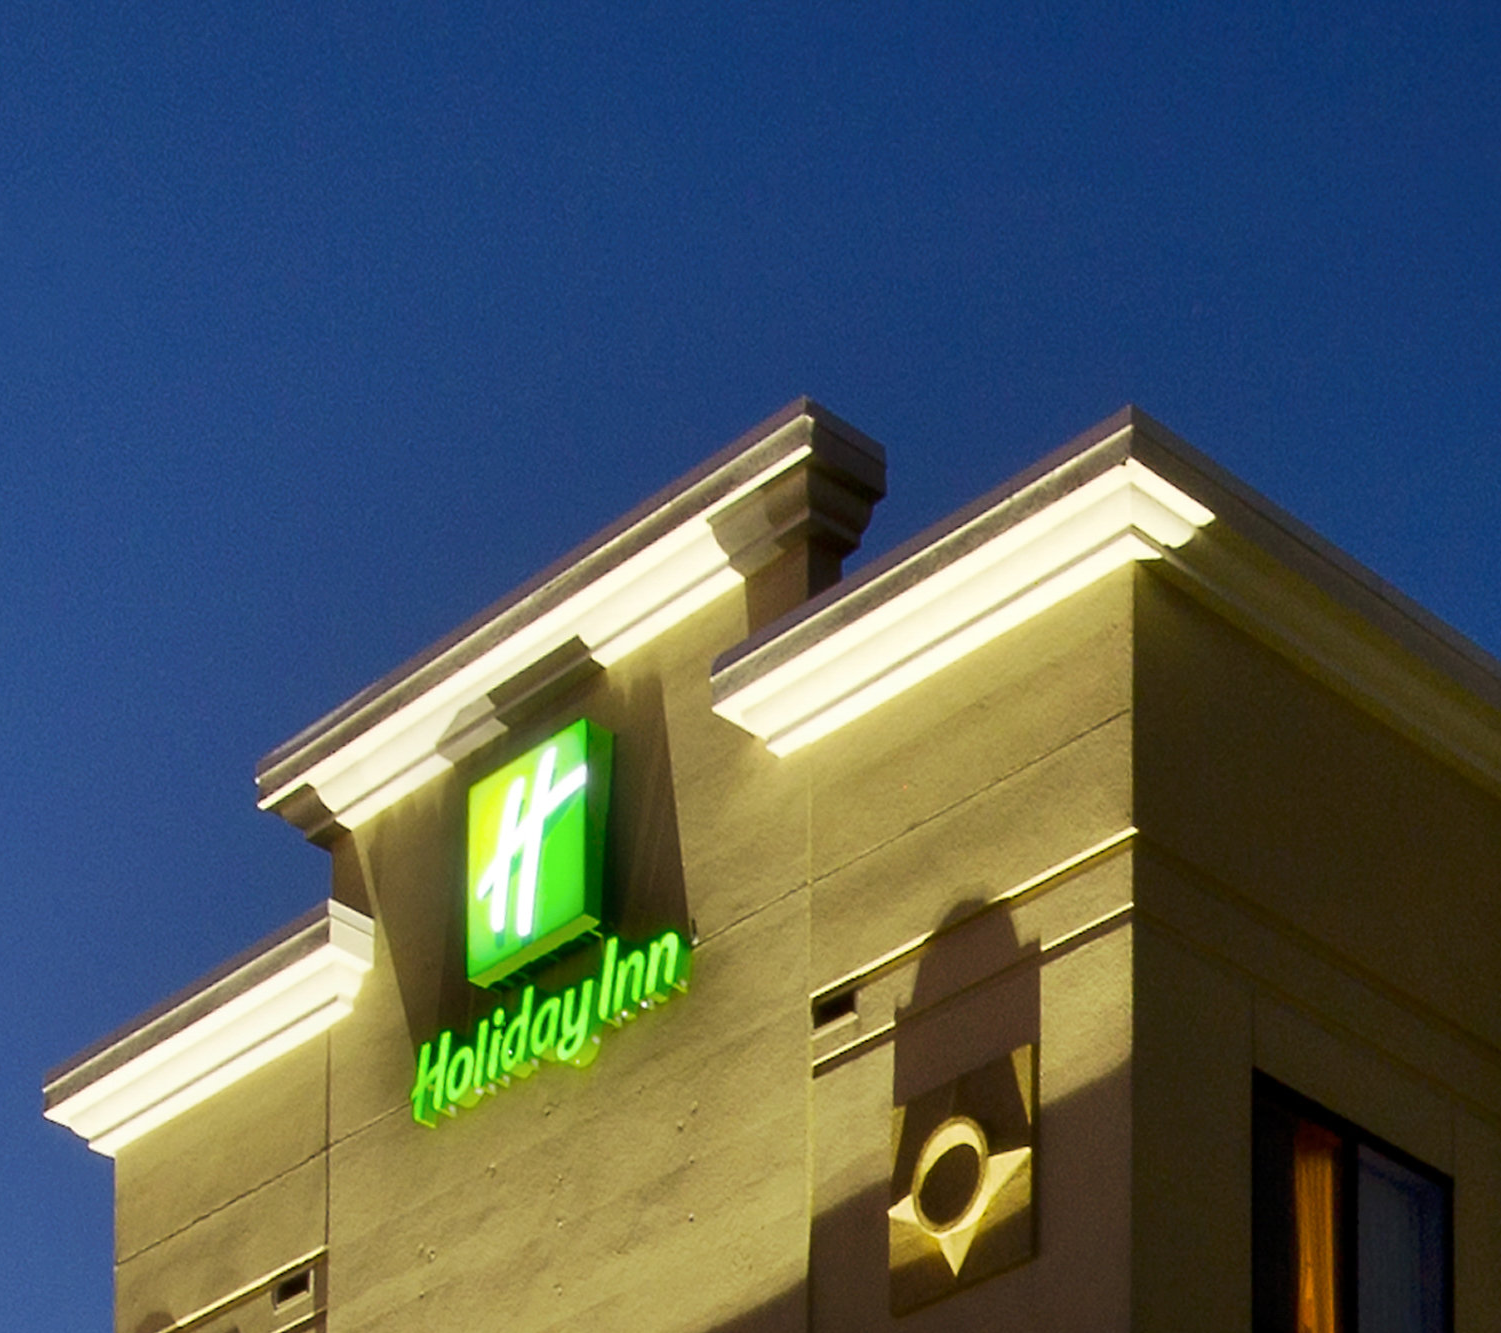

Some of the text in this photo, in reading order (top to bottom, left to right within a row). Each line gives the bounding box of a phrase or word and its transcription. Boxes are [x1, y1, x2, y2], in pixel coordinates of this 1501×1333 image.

[476, 745, 588, 937] H
[411, 931, 681, 1123] Holiday Inn
